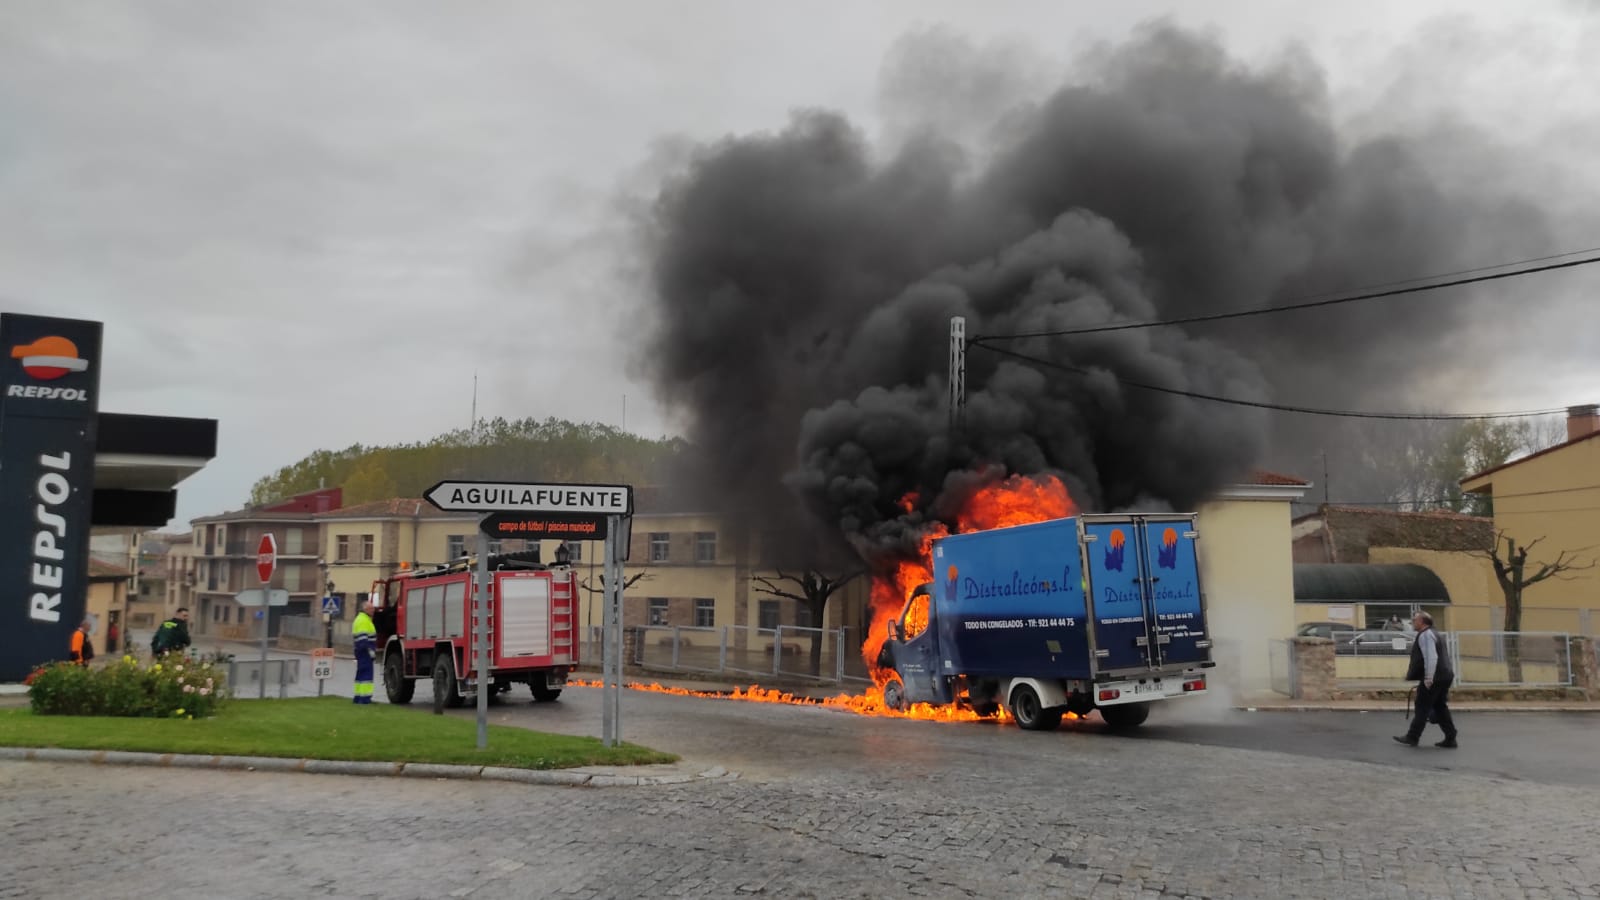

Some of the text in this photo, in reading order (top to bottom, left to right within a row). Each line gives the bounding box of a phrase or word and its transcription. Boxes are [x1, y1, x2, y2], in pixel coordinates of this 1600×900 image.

[8, 384, 88, 401] REPSOL
[450, 488, 622, 507] AGUILAFUENTE
[499, 522, 519, 533] campo
[519, 521, 527, 531] de
[527, 521, 545, 531] fútbol
[548, 521, 568, 533] piscina
[569, 522, 596, 533] municipal
[30, 451, 71, 623] REPSOL
[965, 621, 979, 630] TODO
[980, 621, 988, 629] EN
[988, 619, 1024, 629] CONGELADOS
[1038, 618, 1049, 628] 921
[1049, 618, 1058, 627] 44
[1058, 618, 1066, 626] 44
[1066, 617, 1075, 626] 75
